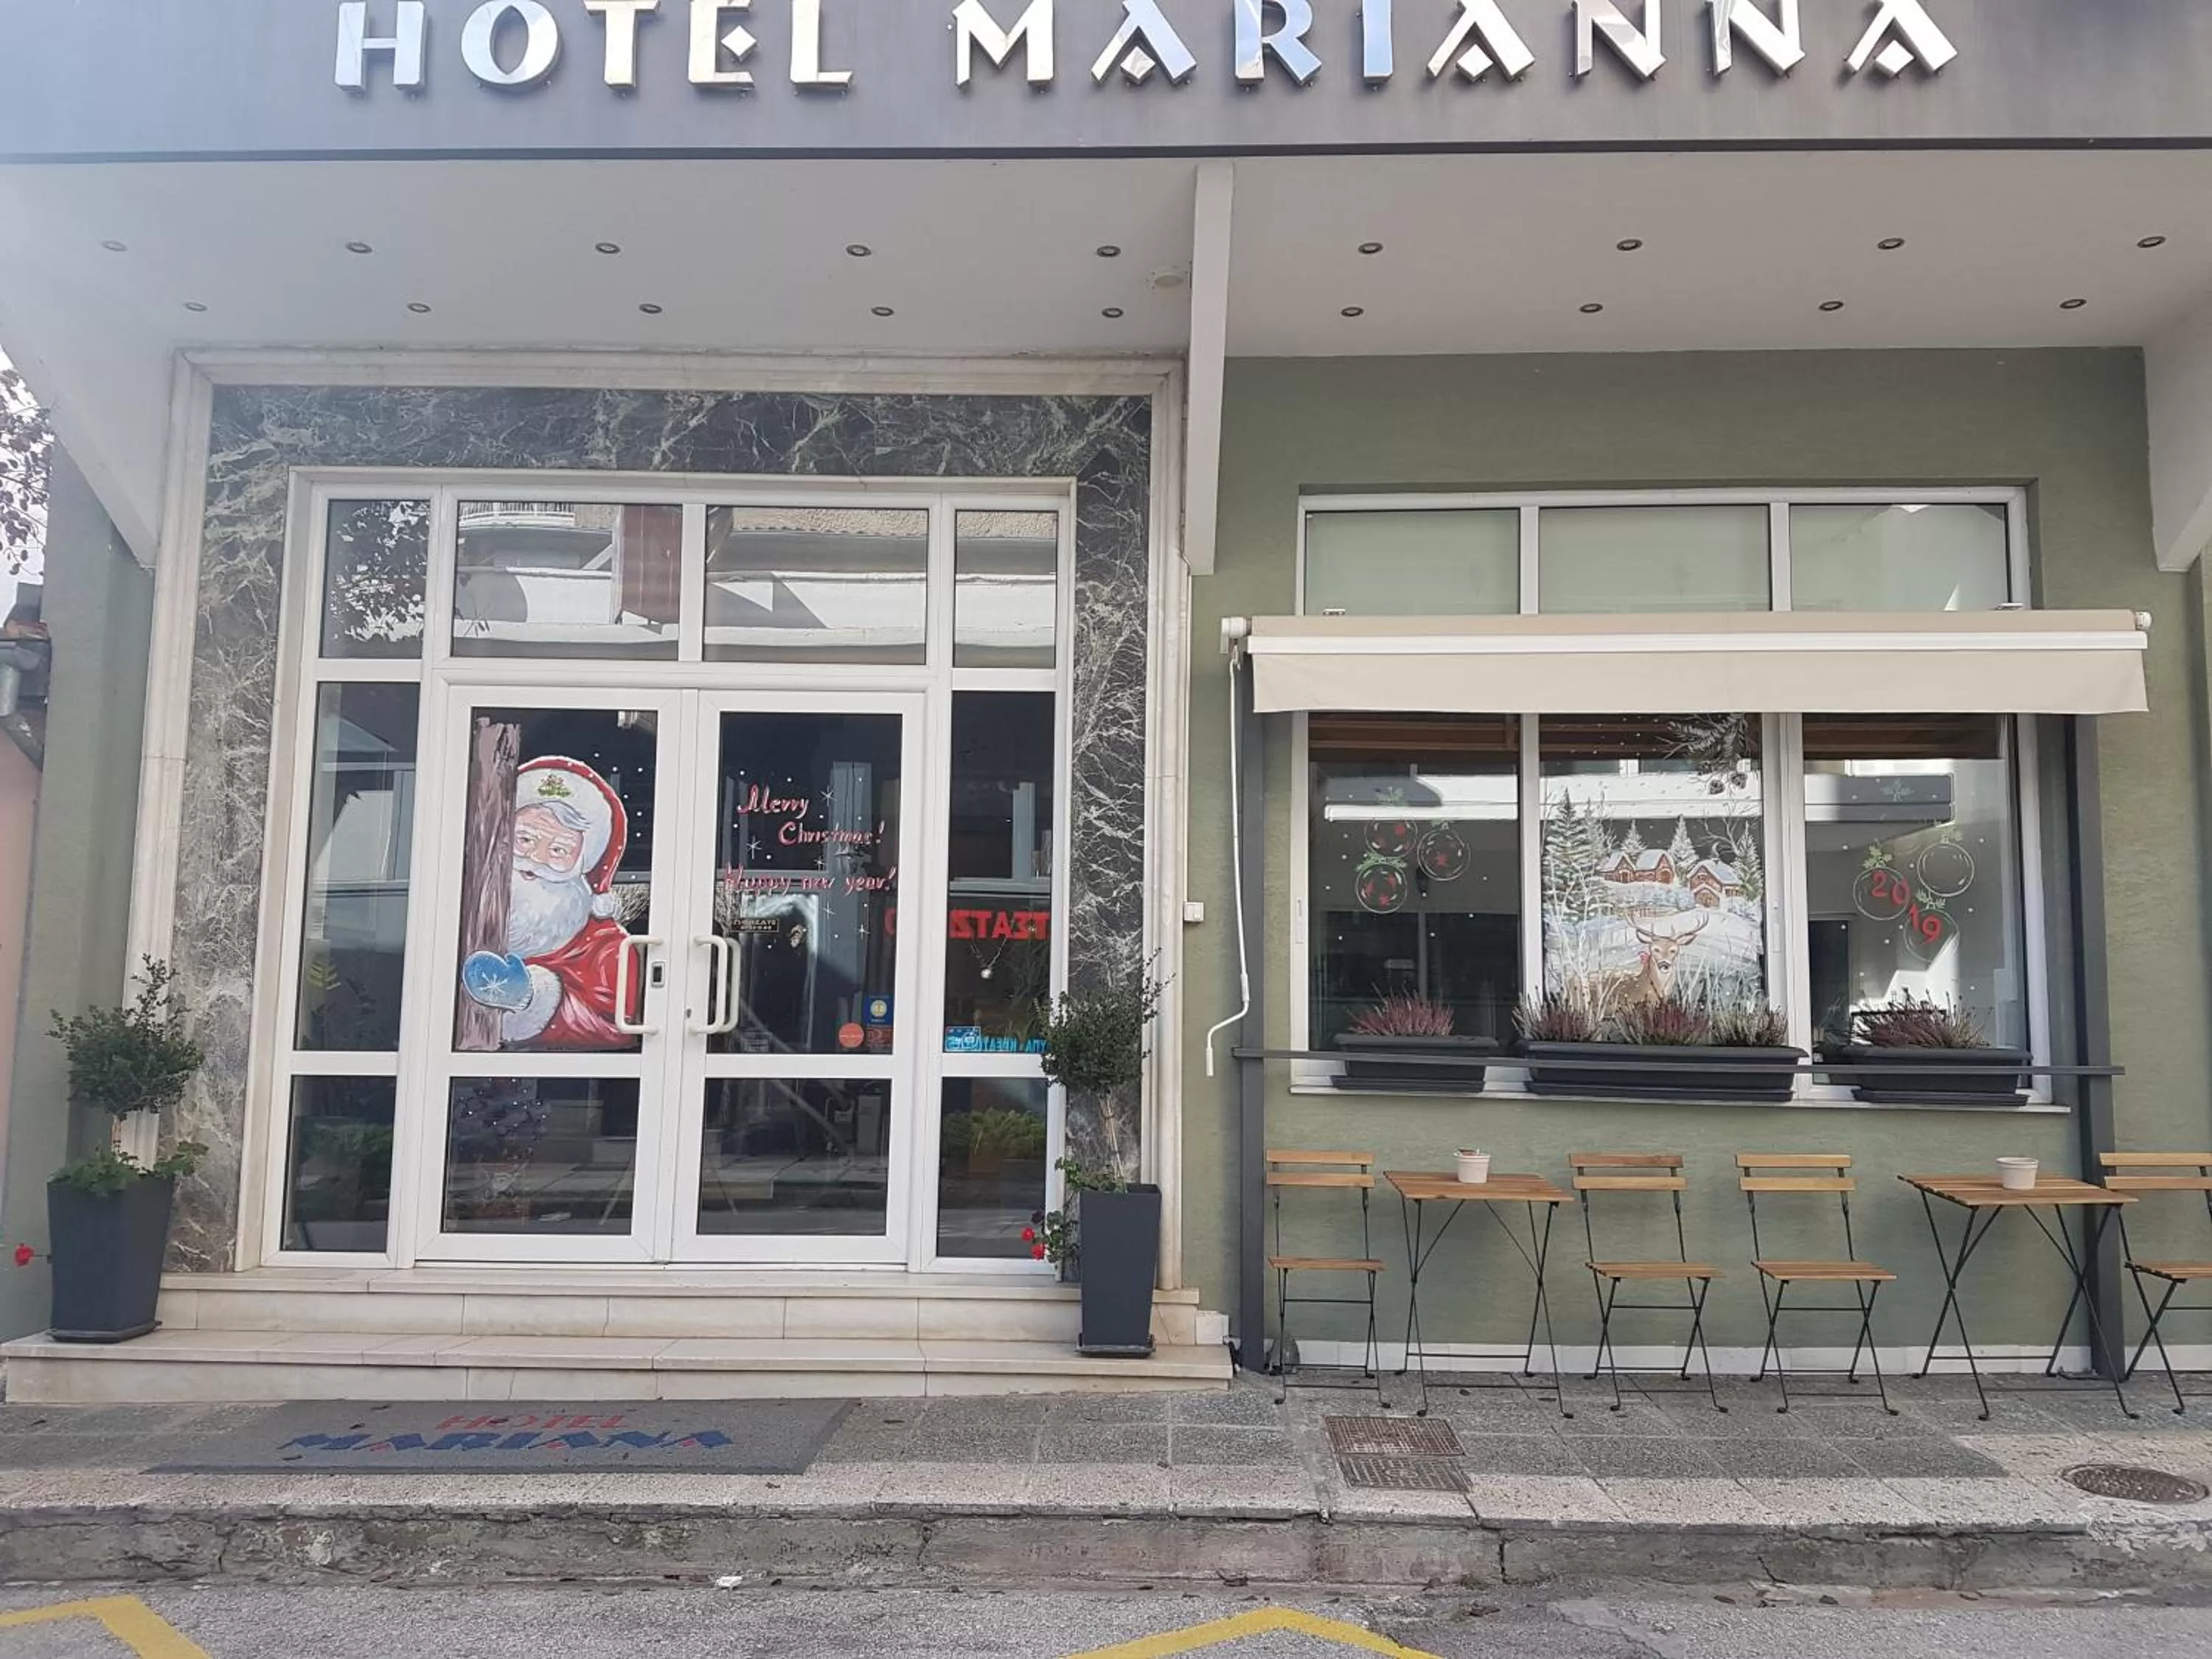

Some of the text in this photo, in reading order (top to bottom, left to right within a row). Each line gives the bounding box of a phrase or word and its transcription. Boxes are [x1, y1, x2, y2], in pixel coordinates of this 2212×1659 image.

[334, 0, 1958, 91] HOTEL MARIANNA
[737, 783, 810, 819] Merry
[434, 1414, 627, 1430] HOTEL
[276, 1430, 733, 1450] MARIANA
